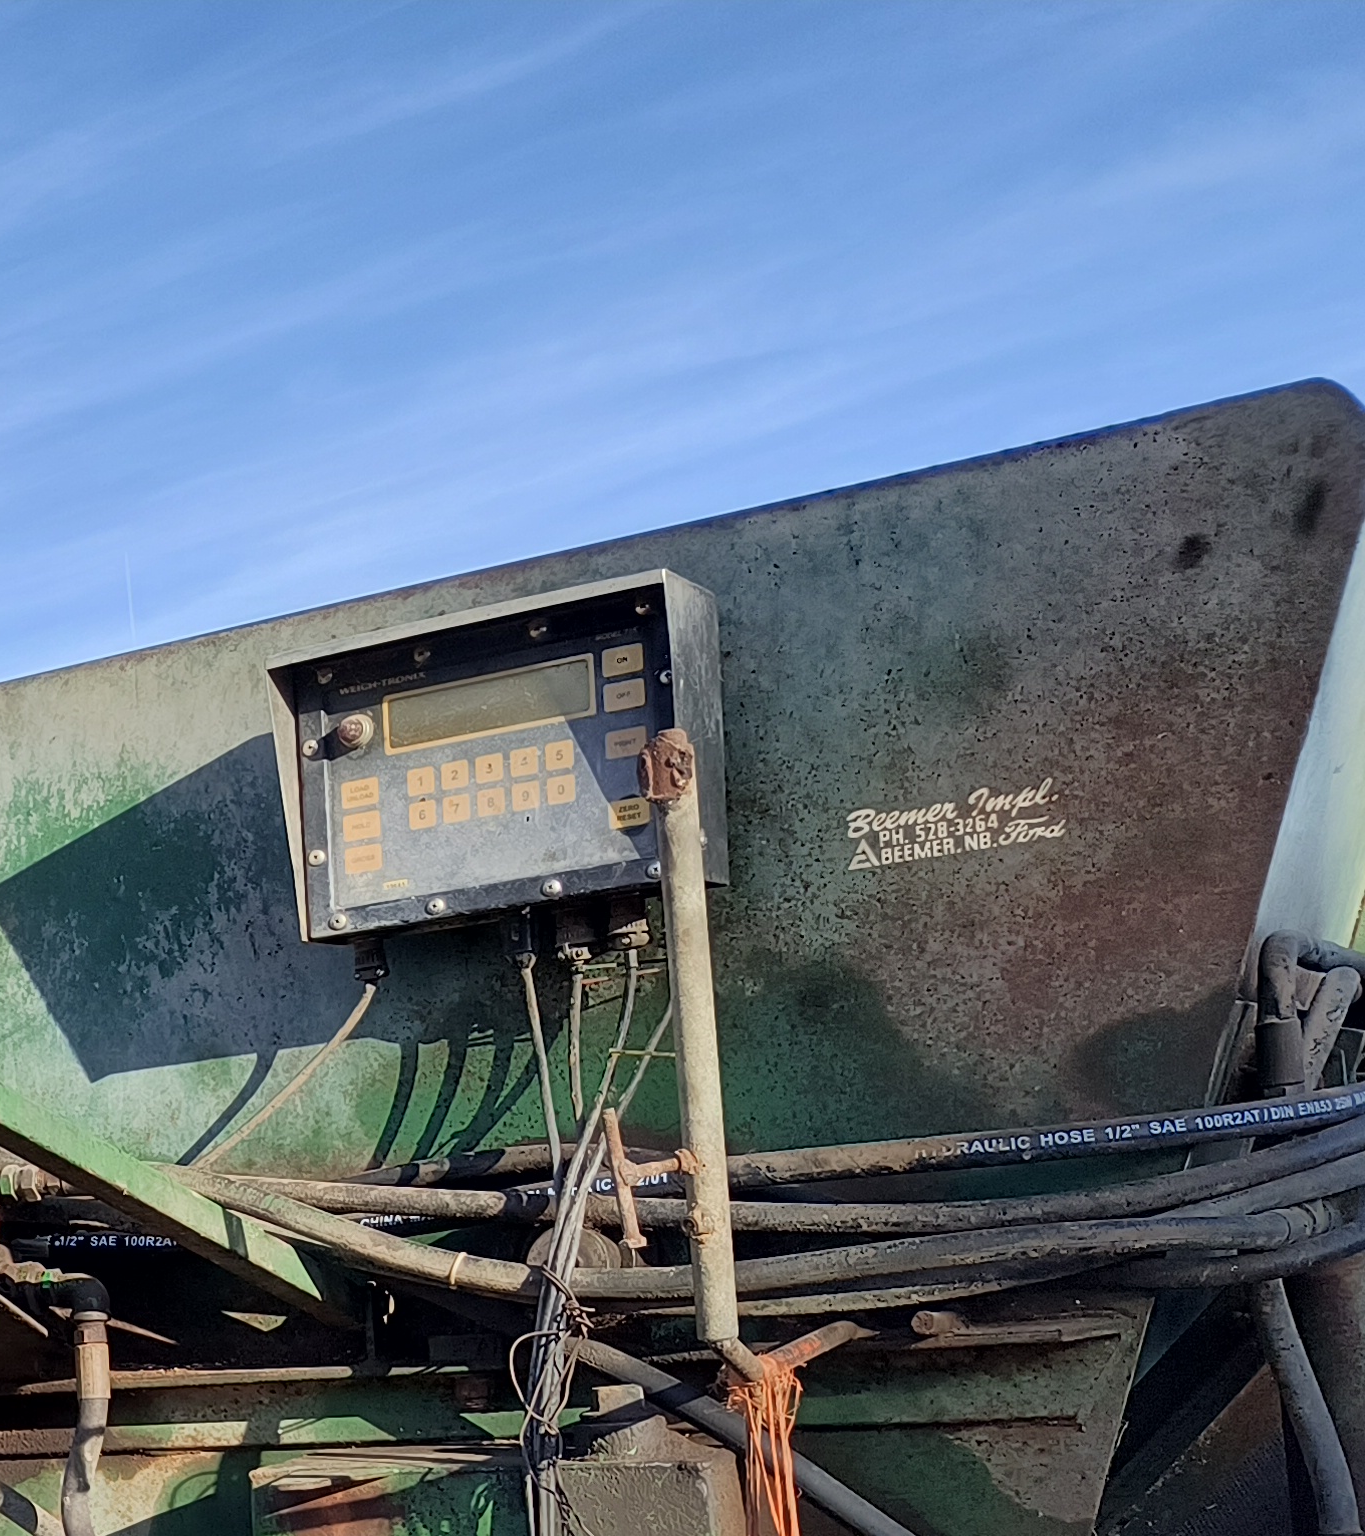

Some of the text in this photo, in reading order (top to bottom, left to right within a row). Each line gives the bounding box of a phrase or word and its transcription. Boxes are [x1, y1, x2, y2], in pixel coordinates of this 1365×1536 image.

[616, 656, 628, 664] ON
[616, 691, 631, 699] OFF
[451, 770, 459, 781] 2
[485, 763, 493, 774] 3
[556, 750, 564, 761] 5
[350, 784, 370, 794] LOAD
[487, 797, 495, 808] 8
[522, 791, 530, 801] 9
[557, 785, 565, 795] 0
[618, 803, 640, 813] ZERO
[616, 812, 642, 822] RESET
[846, 802, 958, 839] Beemer
[879, 813, 999, 848] PH. 528-3264
[964, 831, 998, 852] NB.
[998, 815, 1067, 847] Ford
[1040, 1128, 1095, 1148] HOSE
[1103, 1122, 1140, 1141] 1/2"
[1149, 1117, 1187, 1135] SAE
[360, 1214, 403, 1228] CHINA
[90, 1235, 117, 1247] SAE
[124, 1235, 177, 1247] 100R2A
